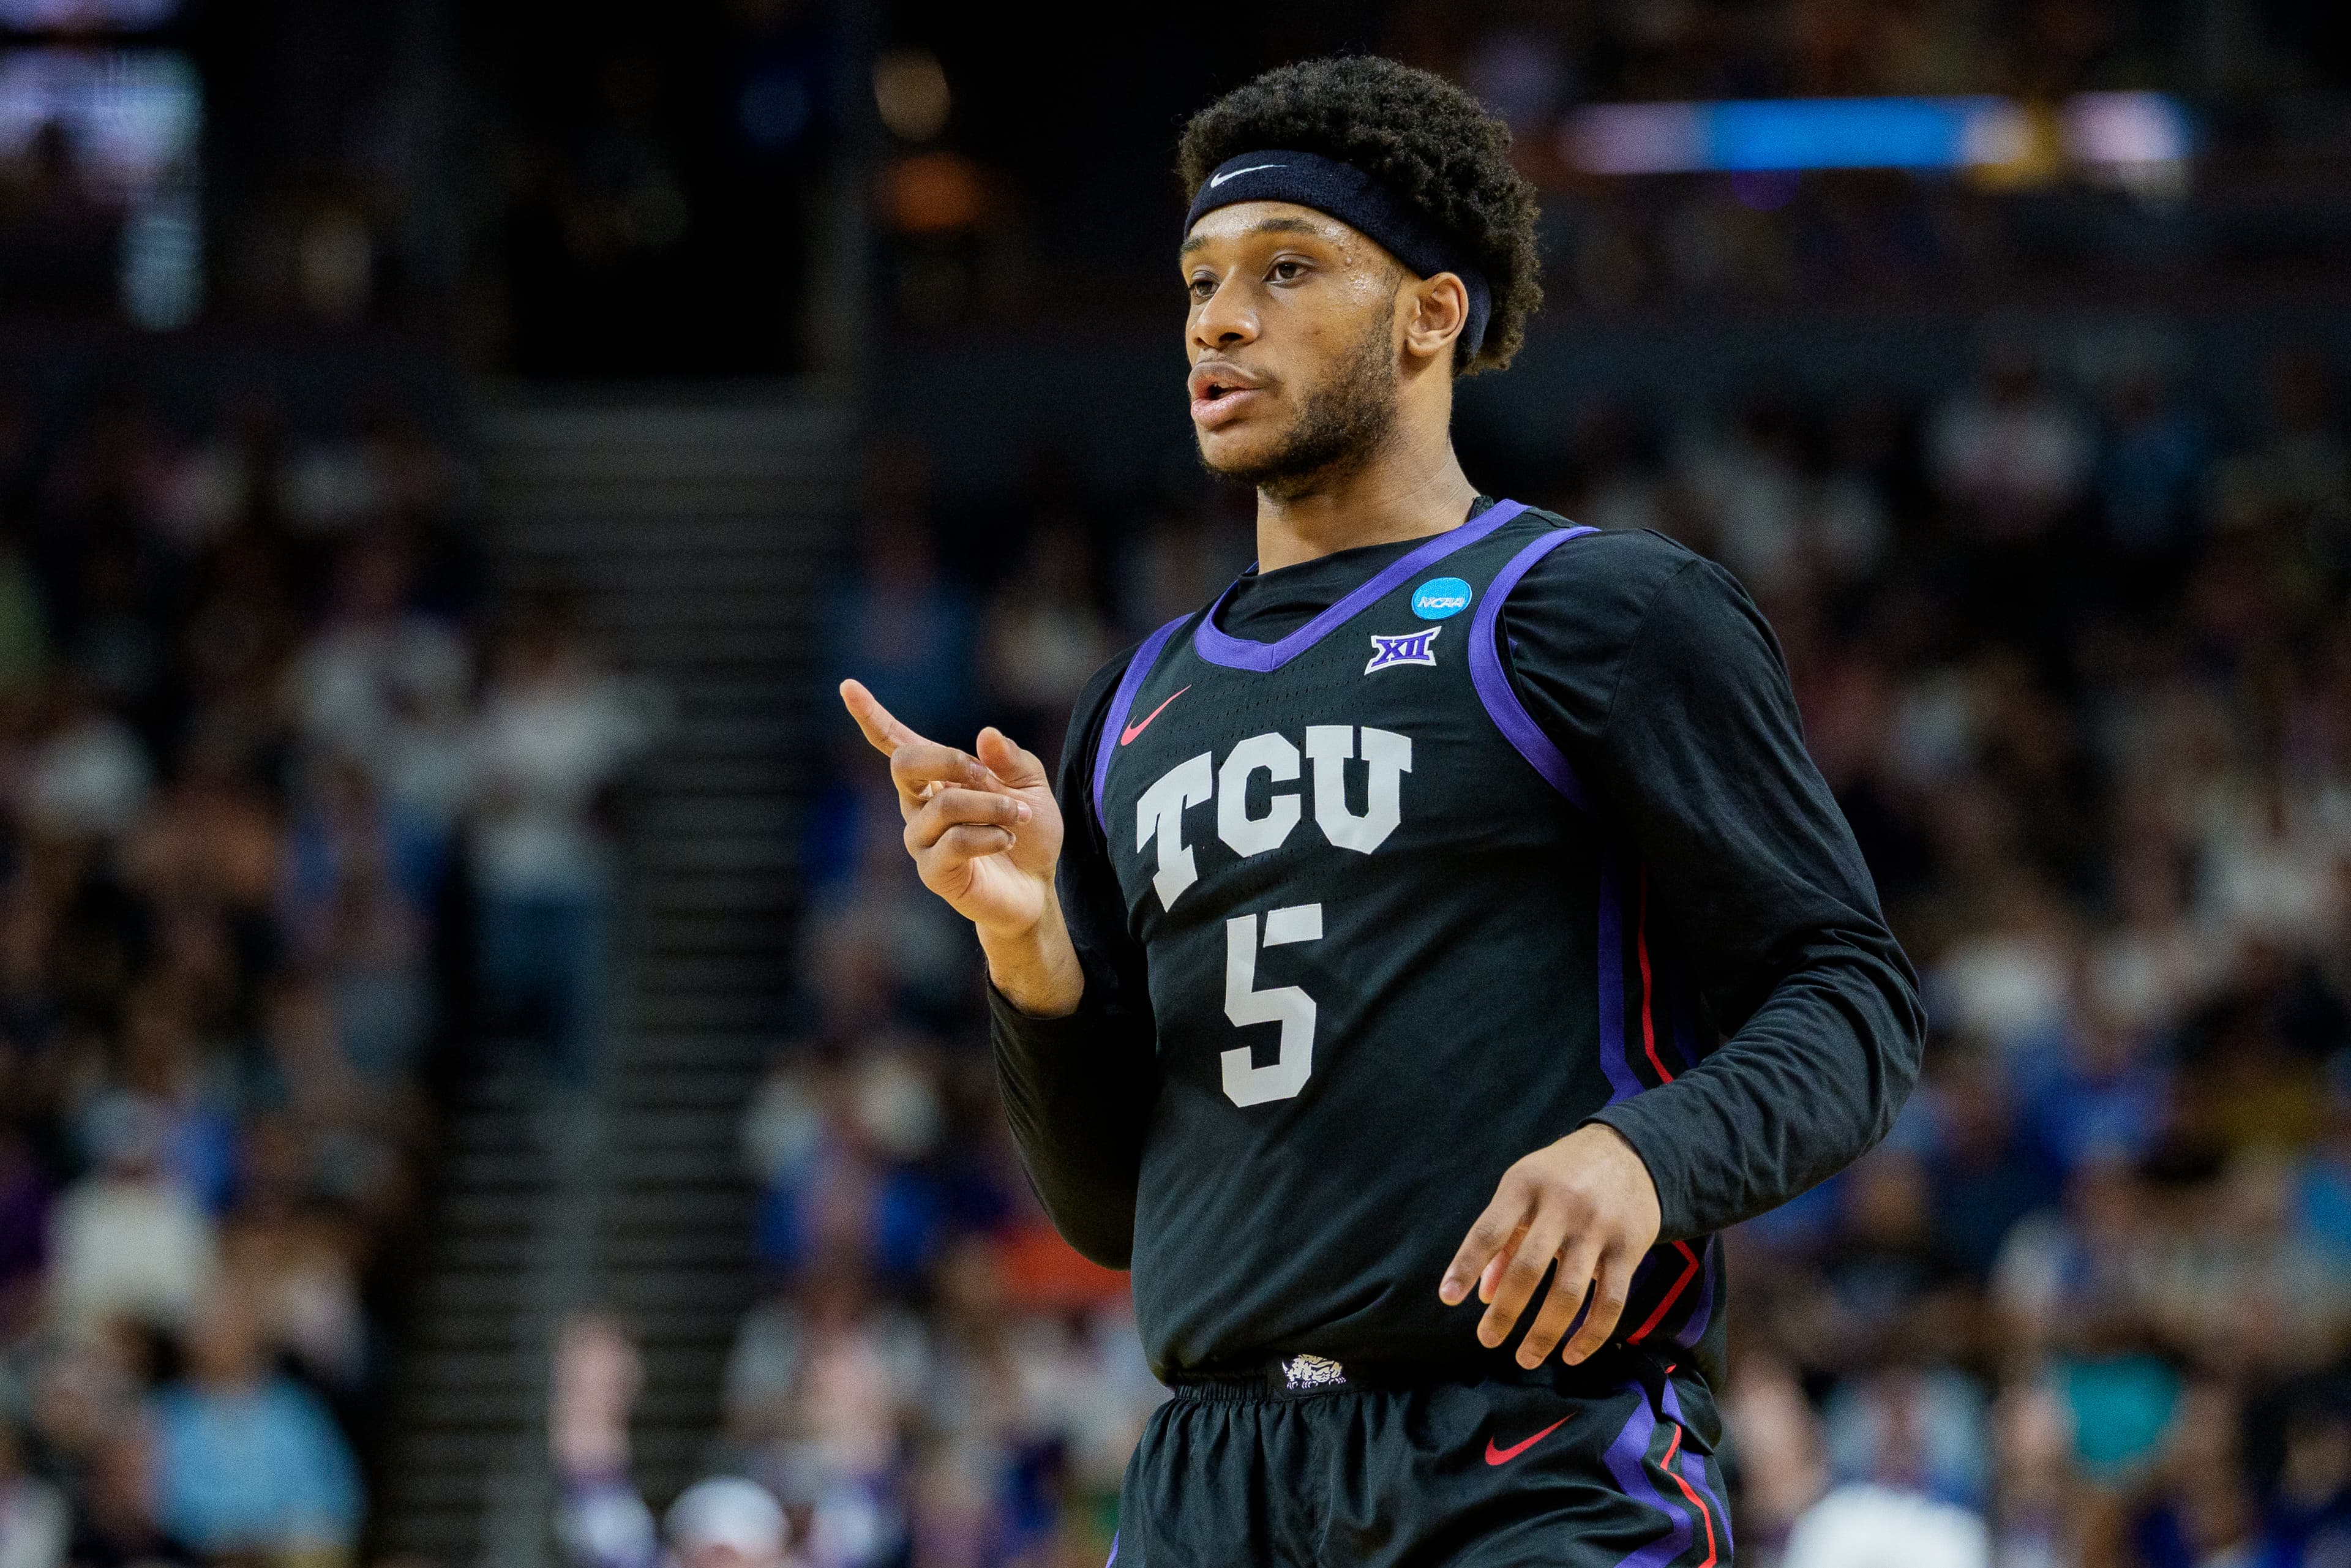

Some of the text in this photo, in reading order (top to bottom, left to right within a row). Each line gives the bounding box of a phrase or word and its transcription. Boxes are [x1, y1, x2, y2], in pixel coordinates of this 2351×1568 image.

[1371, 631, 1435, 667] XII
[1417, 597, 1466, 608] NCAA
[1136, 725, 1412, 913] TCU
[1220, 903, 1324, 1108] 5
